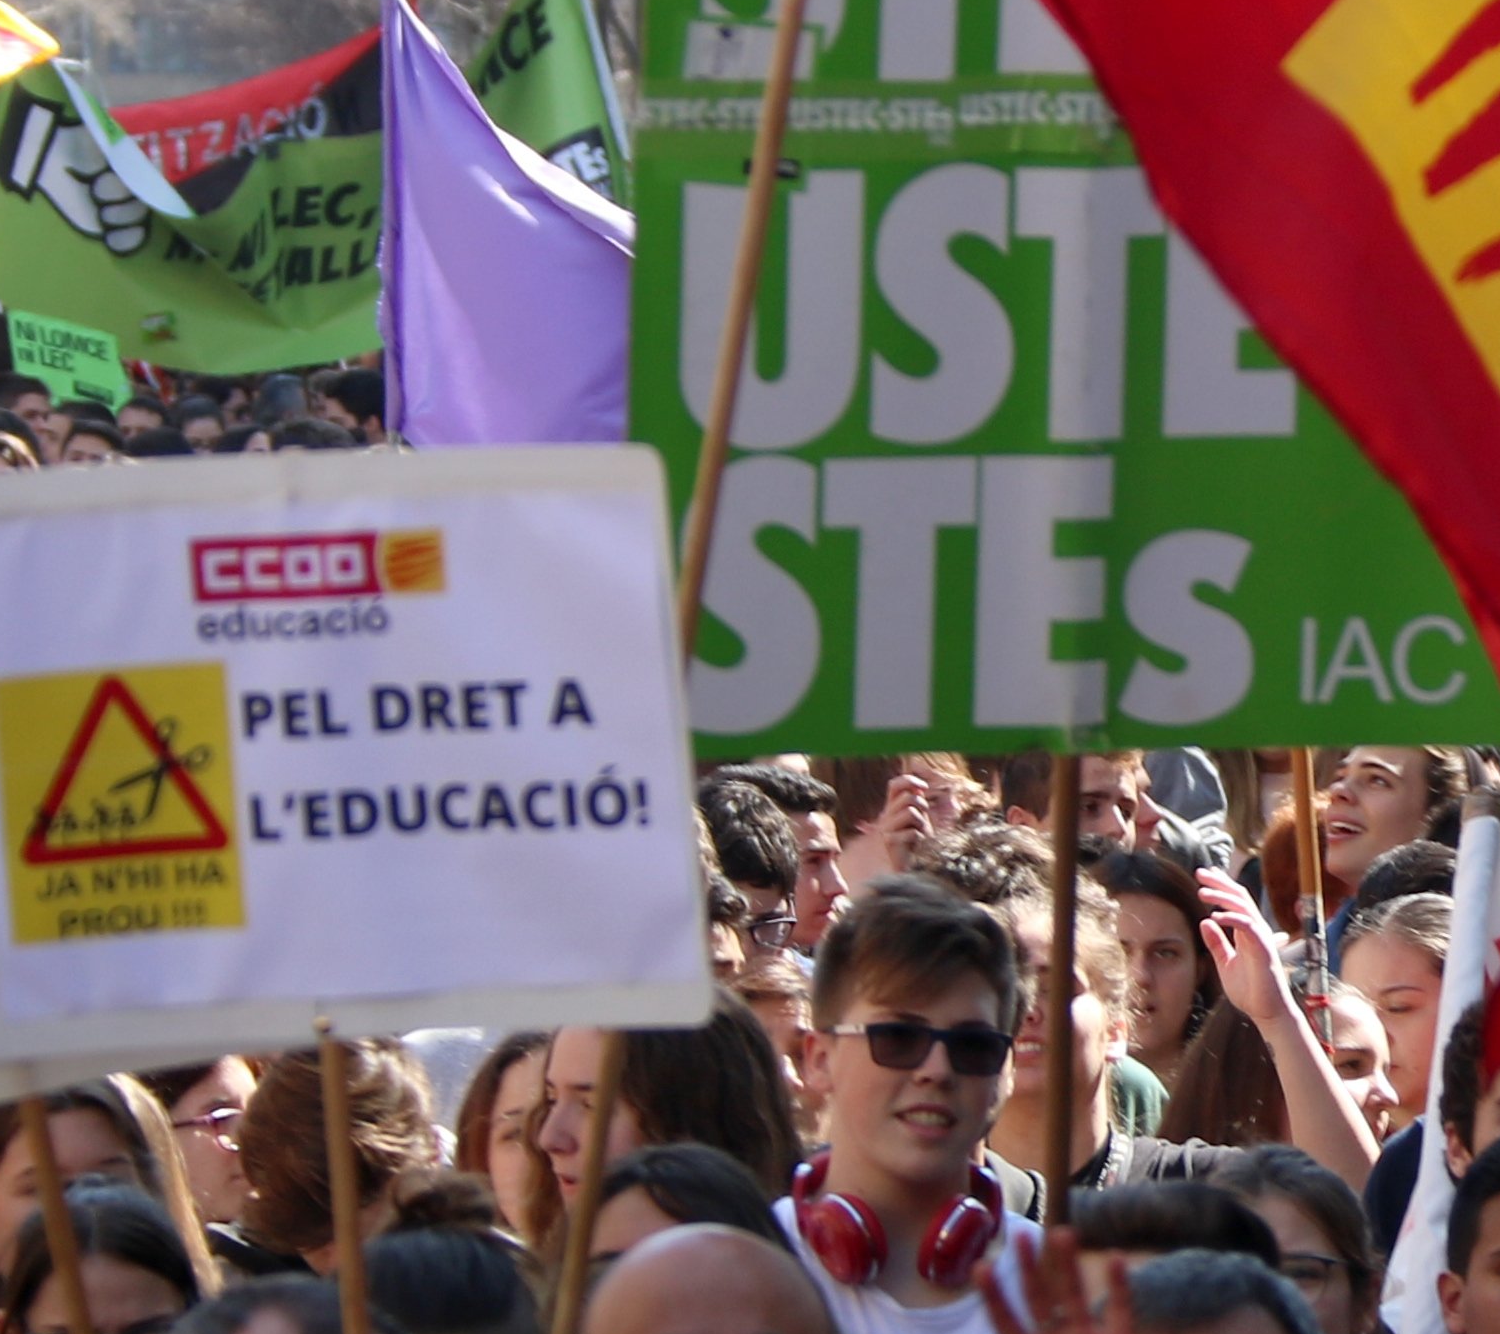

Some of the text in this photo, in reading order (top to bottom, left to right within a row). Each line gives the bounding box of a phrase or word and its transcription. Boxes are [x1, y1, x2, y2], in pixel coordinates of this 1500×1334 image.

[678, 163, 1297, 450] USTE
[200, 540, 368, 594] CCOO
[196, 596, 390, 641] educació
[1302, 615, 1467, 705] IAC
[241, 676, 594, 739] PEL DRET A
[248, 764, 650, 841] L'EDUCACIÓ!
[36, 871, 82, 902] JA
[174, 858, 227, 889] HA
[57, 904, 161, 940] PROU
